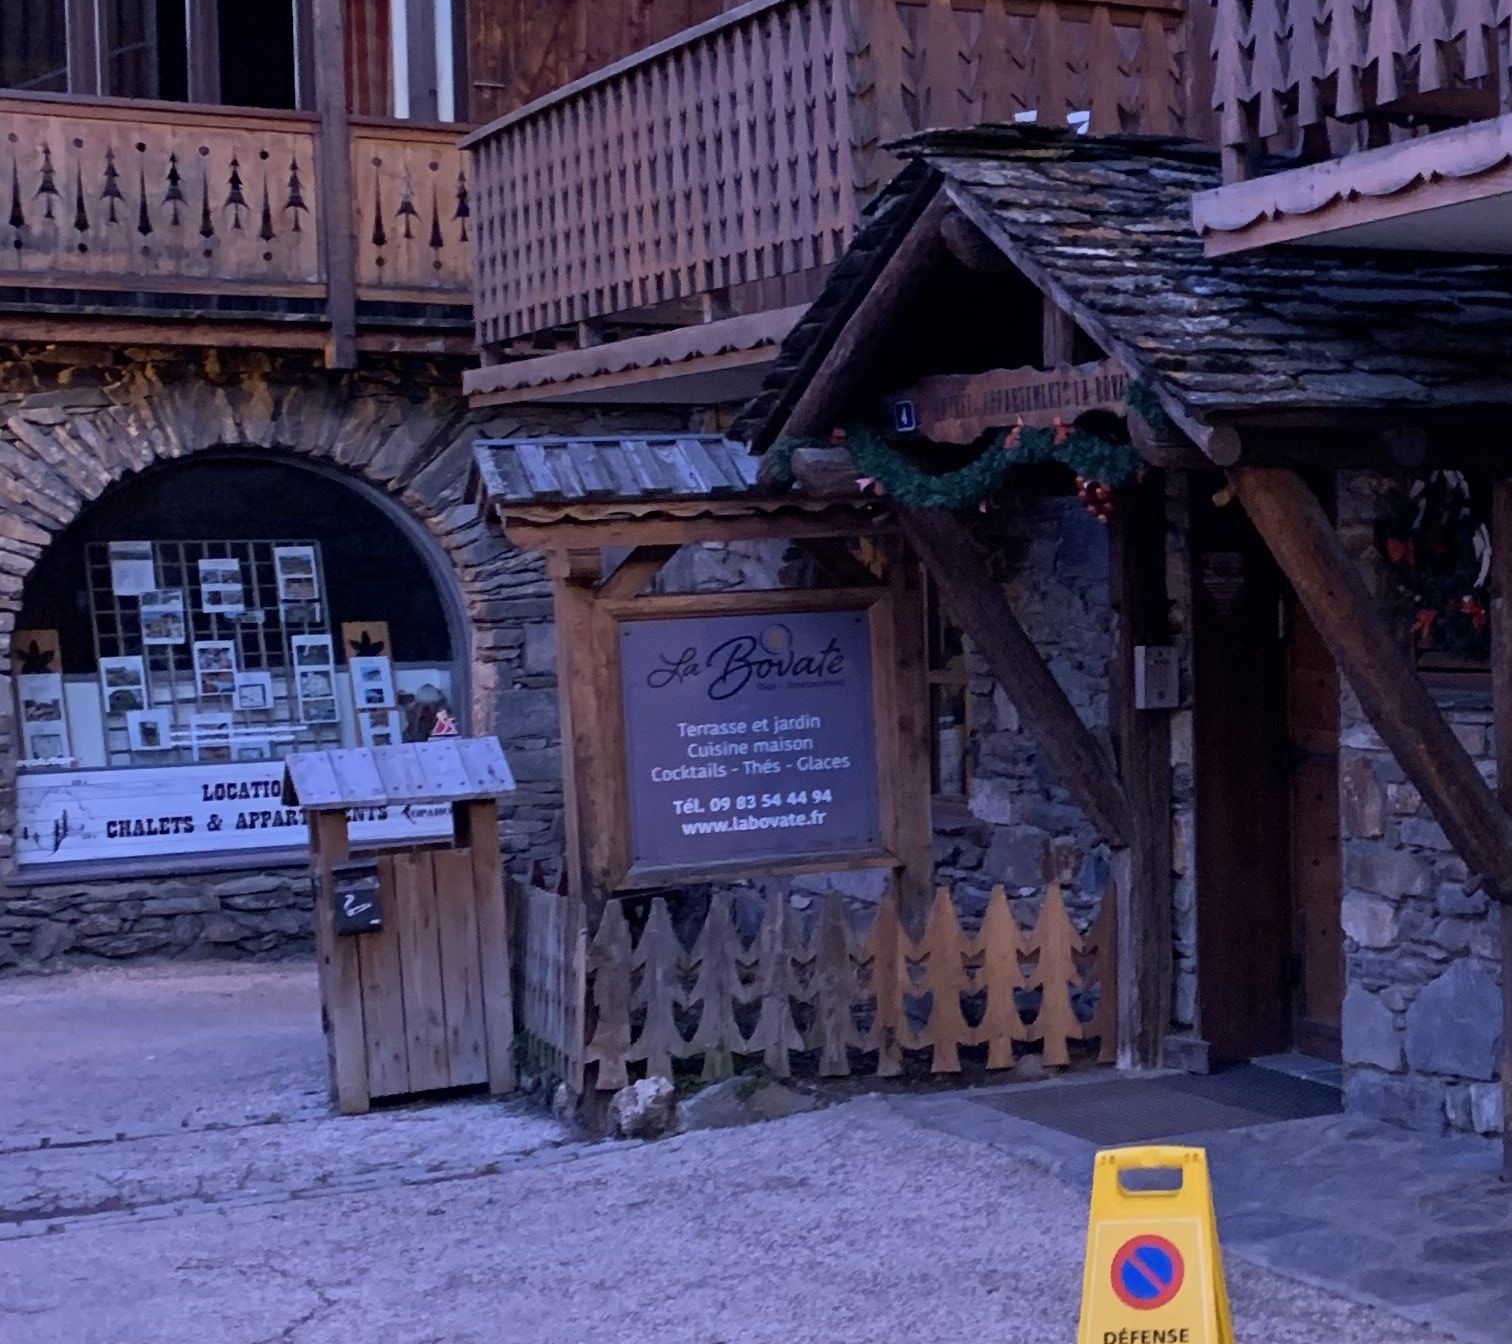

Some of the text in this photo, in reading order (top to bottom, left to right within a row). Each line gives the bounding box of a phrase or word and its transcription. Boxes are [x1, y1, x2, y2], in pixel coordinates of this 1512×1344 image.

[647, 635, 846, 701] La Bovate
[678, 713, 821, 738] Terrasse et jardin
[687, 737, 814, 758] Cuisine maison
[651, 762, 728, 782] Cocktails
[743, 759, 782, 775] Thés
[797, 755, 851, 772] Glaces
[202, 780, 282, 802] LOCATIO
[709, 797, 731, 812] 09
[761, 793, 782, 807] 54
[786, 791, 807, 806] 44
[812, 789, 832, 804] 94
[106, 815, 194, 840] CHALETS
[207, 814, 224, 832] &
[682, 808, 827, 836] www.labovate.fr
